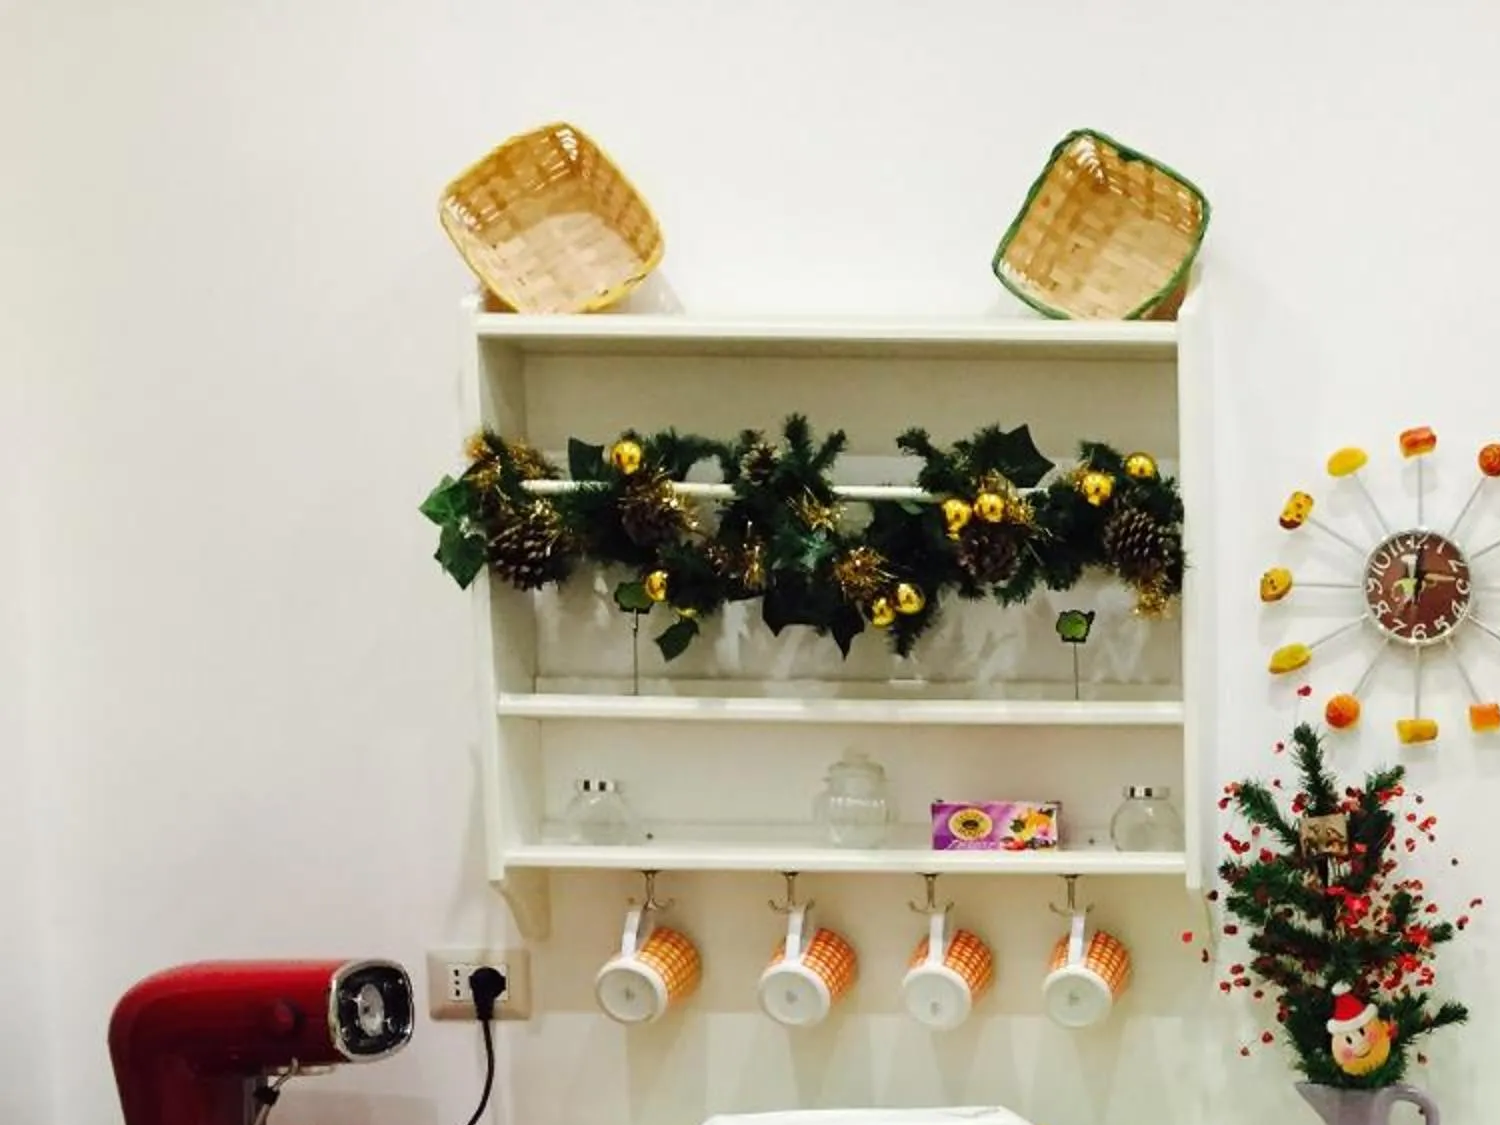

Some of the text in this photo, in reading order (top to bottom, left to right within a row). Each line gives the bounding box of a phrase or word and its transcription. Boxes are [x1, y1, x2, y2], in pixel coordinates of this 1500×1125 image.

[1436, 541, 1446, 555] 1
[1370, 551, 1391, 577] 10
[1391, 617, 1408, 633] 7
[1411, 623, 1427, 641] 6
[1434, 615, 1451, 633] 5
